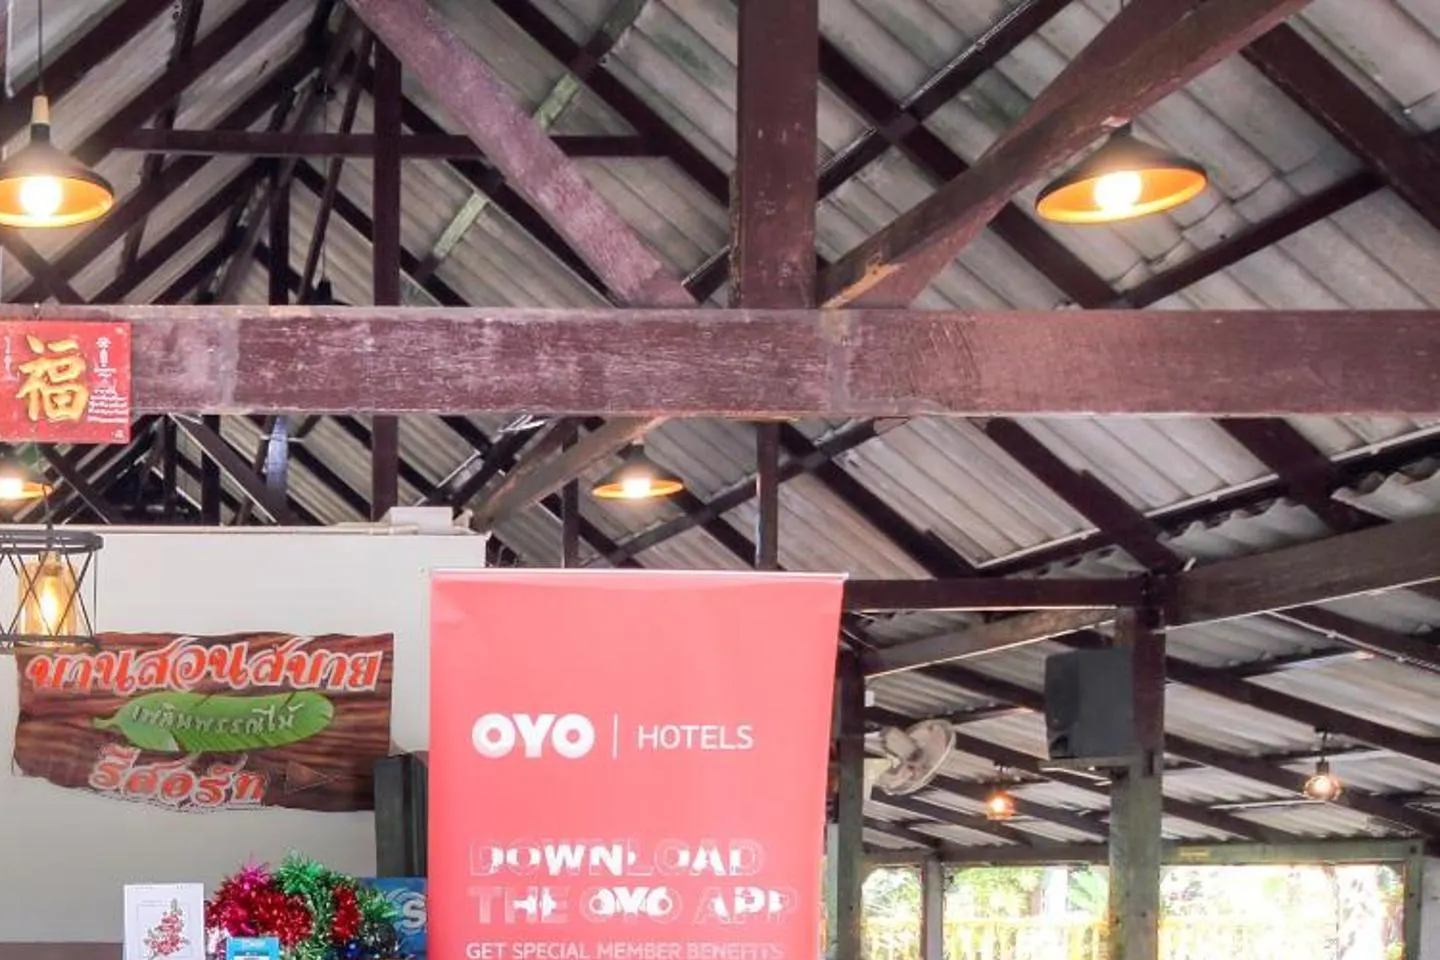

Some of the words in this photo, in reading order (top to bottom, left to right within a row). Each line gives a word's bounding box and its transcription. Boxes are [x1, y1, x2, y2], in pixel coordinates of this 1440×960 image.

[472, 712, 595, 759] OYO
[637, 724, 754, 750] HOTELS
[469, 838, 764, 877] DOWNLOAD
[468, 886, 567, 924] THE
[580, 886, 683, 924] OYO
[692, 886, 799, 925] APP
[466, 942, 505, 960] GET
